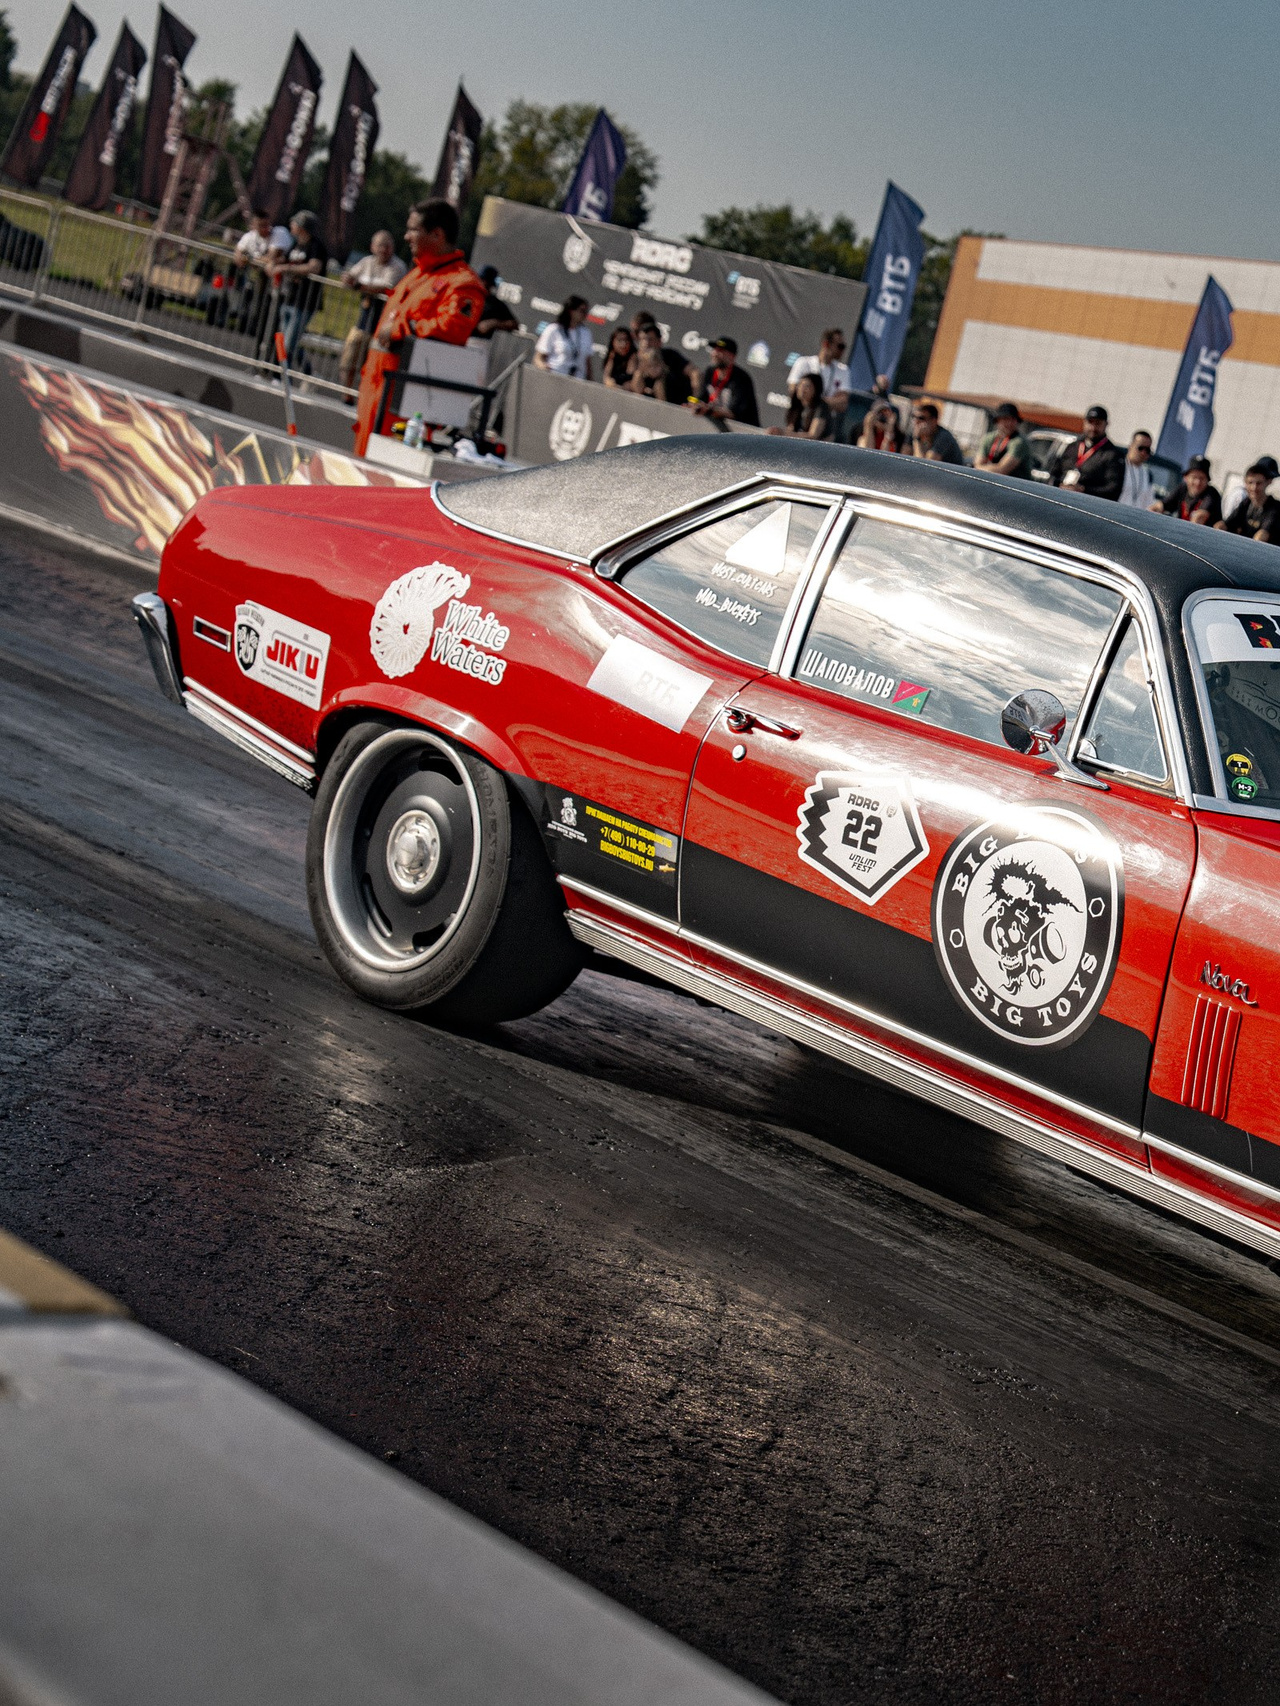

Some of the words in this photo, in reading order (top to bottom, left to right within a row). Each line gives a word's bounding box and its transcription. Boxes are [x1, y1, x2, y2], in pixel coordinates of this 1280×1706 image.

[578, 181, 608, 221] ТБ
[876, 253, 912, 316] ВТБ
[1187, 346, 1220, 407] ВТБ
[445, 602, 507, 648] White
[433, 630, 504, 683] Waters
[799, 648, 896, 699] ШАПОВАЛОВ
[846, 792, 881, 812] RDRC
[1237, 783, 1253, 793] M-2
[841, 808, 883, 855] 22
[851, 861, 873, 874] FEST
[952, 835, 999, 898] BIG
[970, 976, 1024, 1027] BIG
[1037, 951, 1098, 1027] TOYS
[1198, 959, 1258, 1006] Nova
